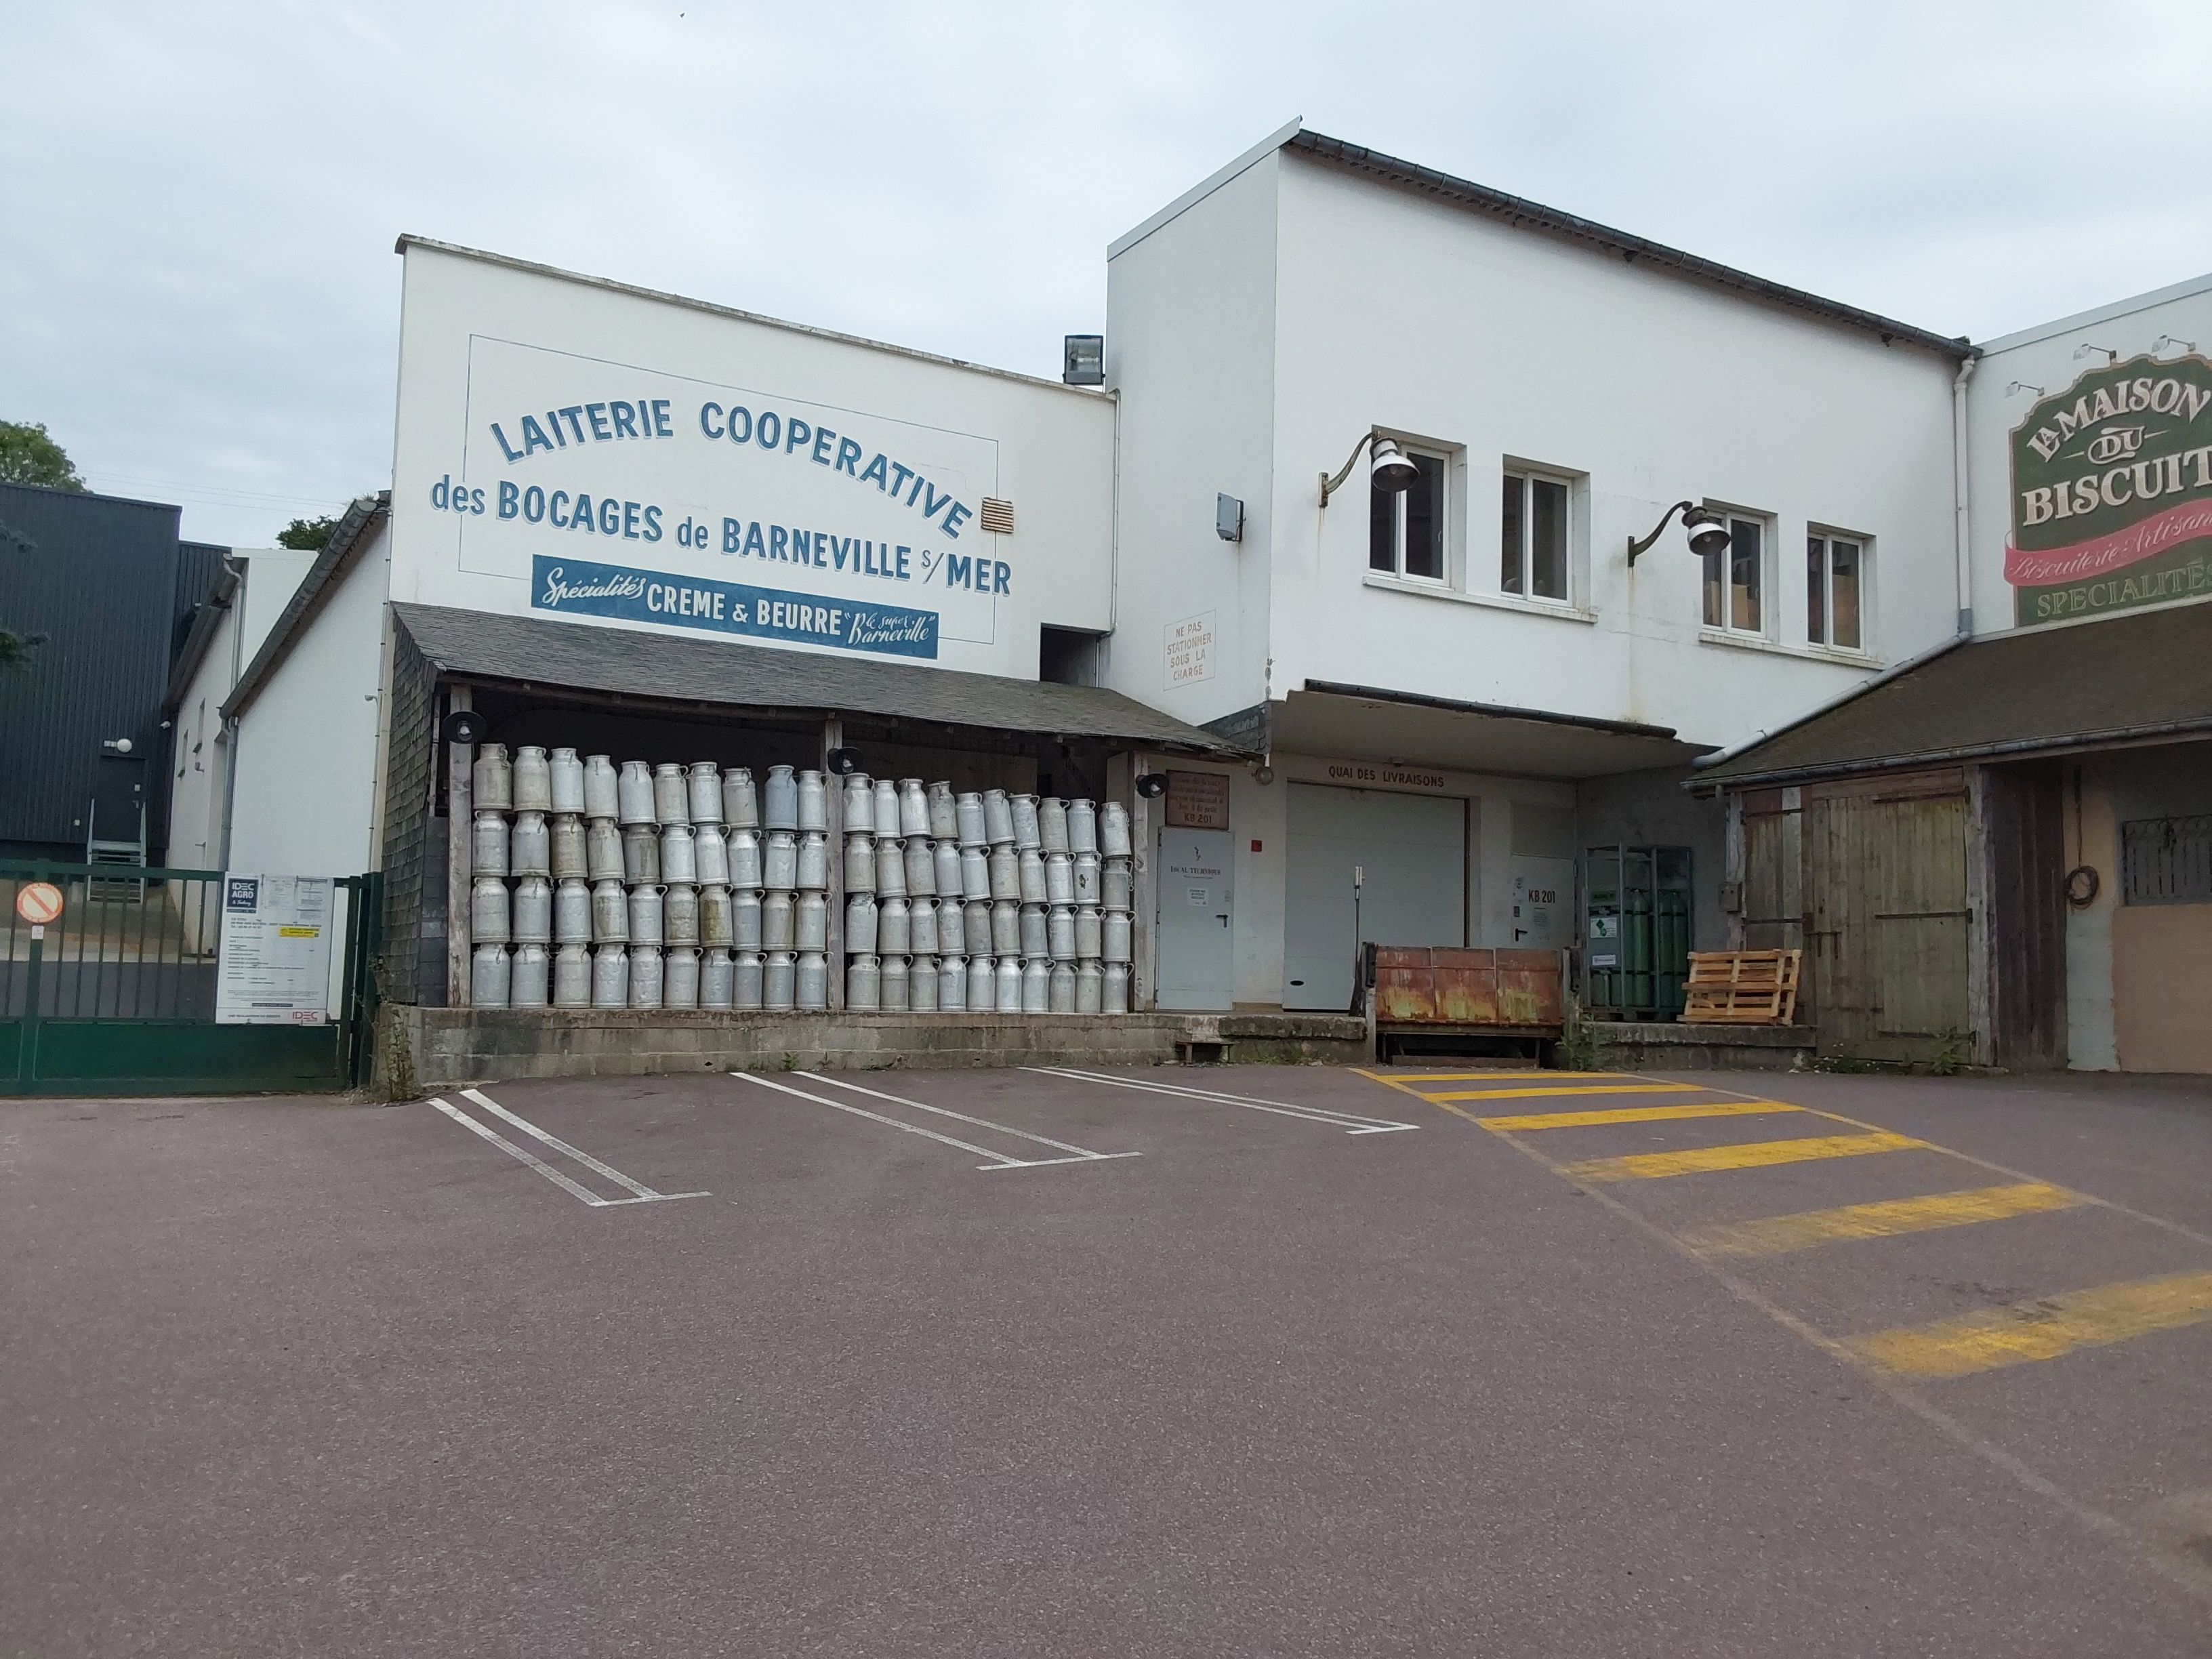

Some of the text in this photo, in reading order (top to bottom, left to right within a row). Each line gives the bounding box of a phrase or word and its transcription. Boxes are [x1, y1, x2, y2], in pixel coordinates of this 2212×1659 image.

[2053, 377, 2211, 442] MAISON
[2095, 426, 2145, 461] DU
[489, 398, 974, 539] LAITERIE COOPERATIVE
[2022, 445, 2212, 526] BISCUIT
[431, 474, 485, 516] des
[496, 480, 663, 543] BOCAGES
[676, 516, 709, 550] de
[720, 516, 912, 581] BARNEVILLE
[542, 567, 842, 636] Spécialités CREME & BEURRE
[1176, 621, 1202, 638] NE PAS
[1167, 632, 1212, 655] STATIONNER
[1170, 649, 1206, 668] SOUS LA
[1173, 664, 1203, 681] CHARGE
[1328, 765, 1444, 787] QUAI DES LIVRAISONS
[1197, 814, 1212, 823] 201
[231, 890, 254, 899] AGRO
[232, 882, 255, 891] IDEC
[1528, 889, 1555, 903] KB 201
[293, 1011, 318, 1019] IDEC
